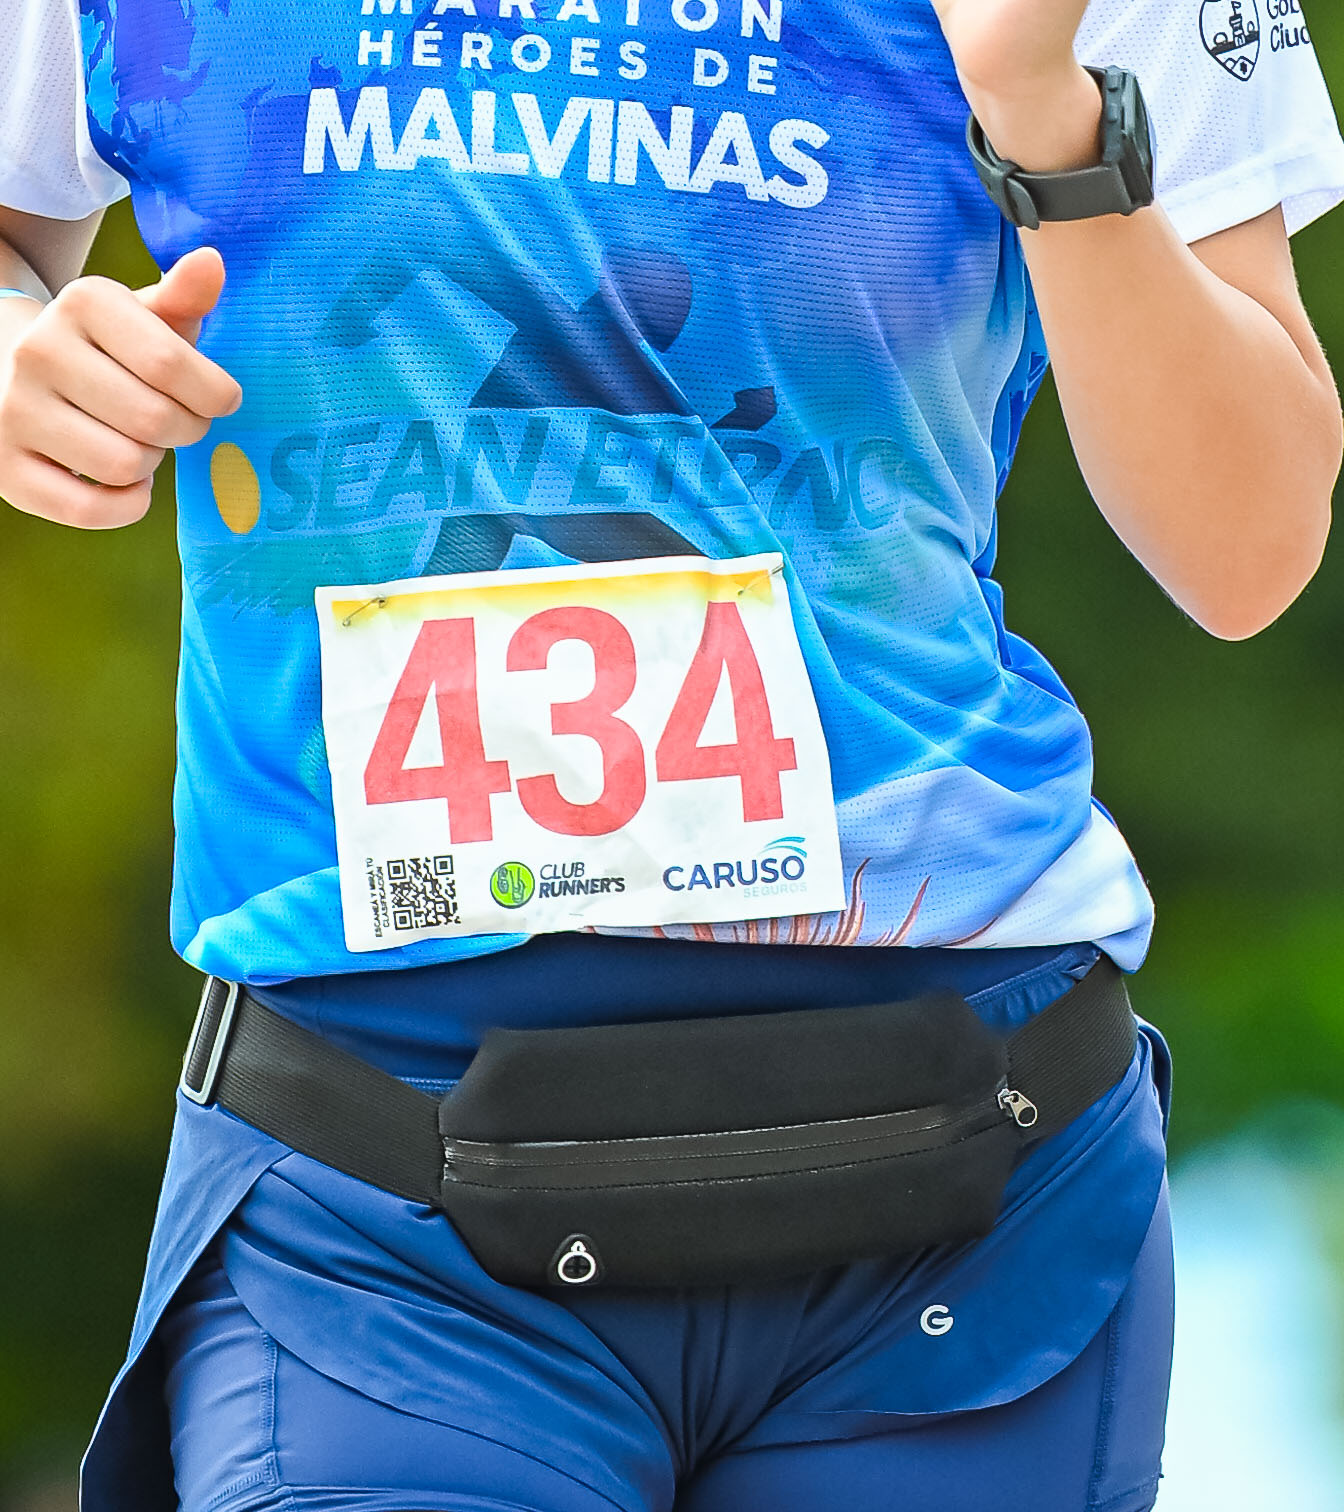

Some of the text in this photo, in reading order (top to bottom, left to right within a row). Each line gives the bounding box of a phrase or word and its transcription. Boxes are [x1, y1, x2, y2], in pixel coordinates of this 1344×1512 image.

[357, 22, 778, 95] HÉROES DE
[303, 86, 831, 208] MALVINAS
[266, 414, 552, 532] SEAN
[363, 601, 798, 845] 434
[538, 877, 626, 899] RUNNER'S
[539, 861, 585, 881] CLUB
[662, 855, 805, 892] CARUSO
[743, 880, 808, 899] SEGUROS
[920, 1304, 954, 1336] G
